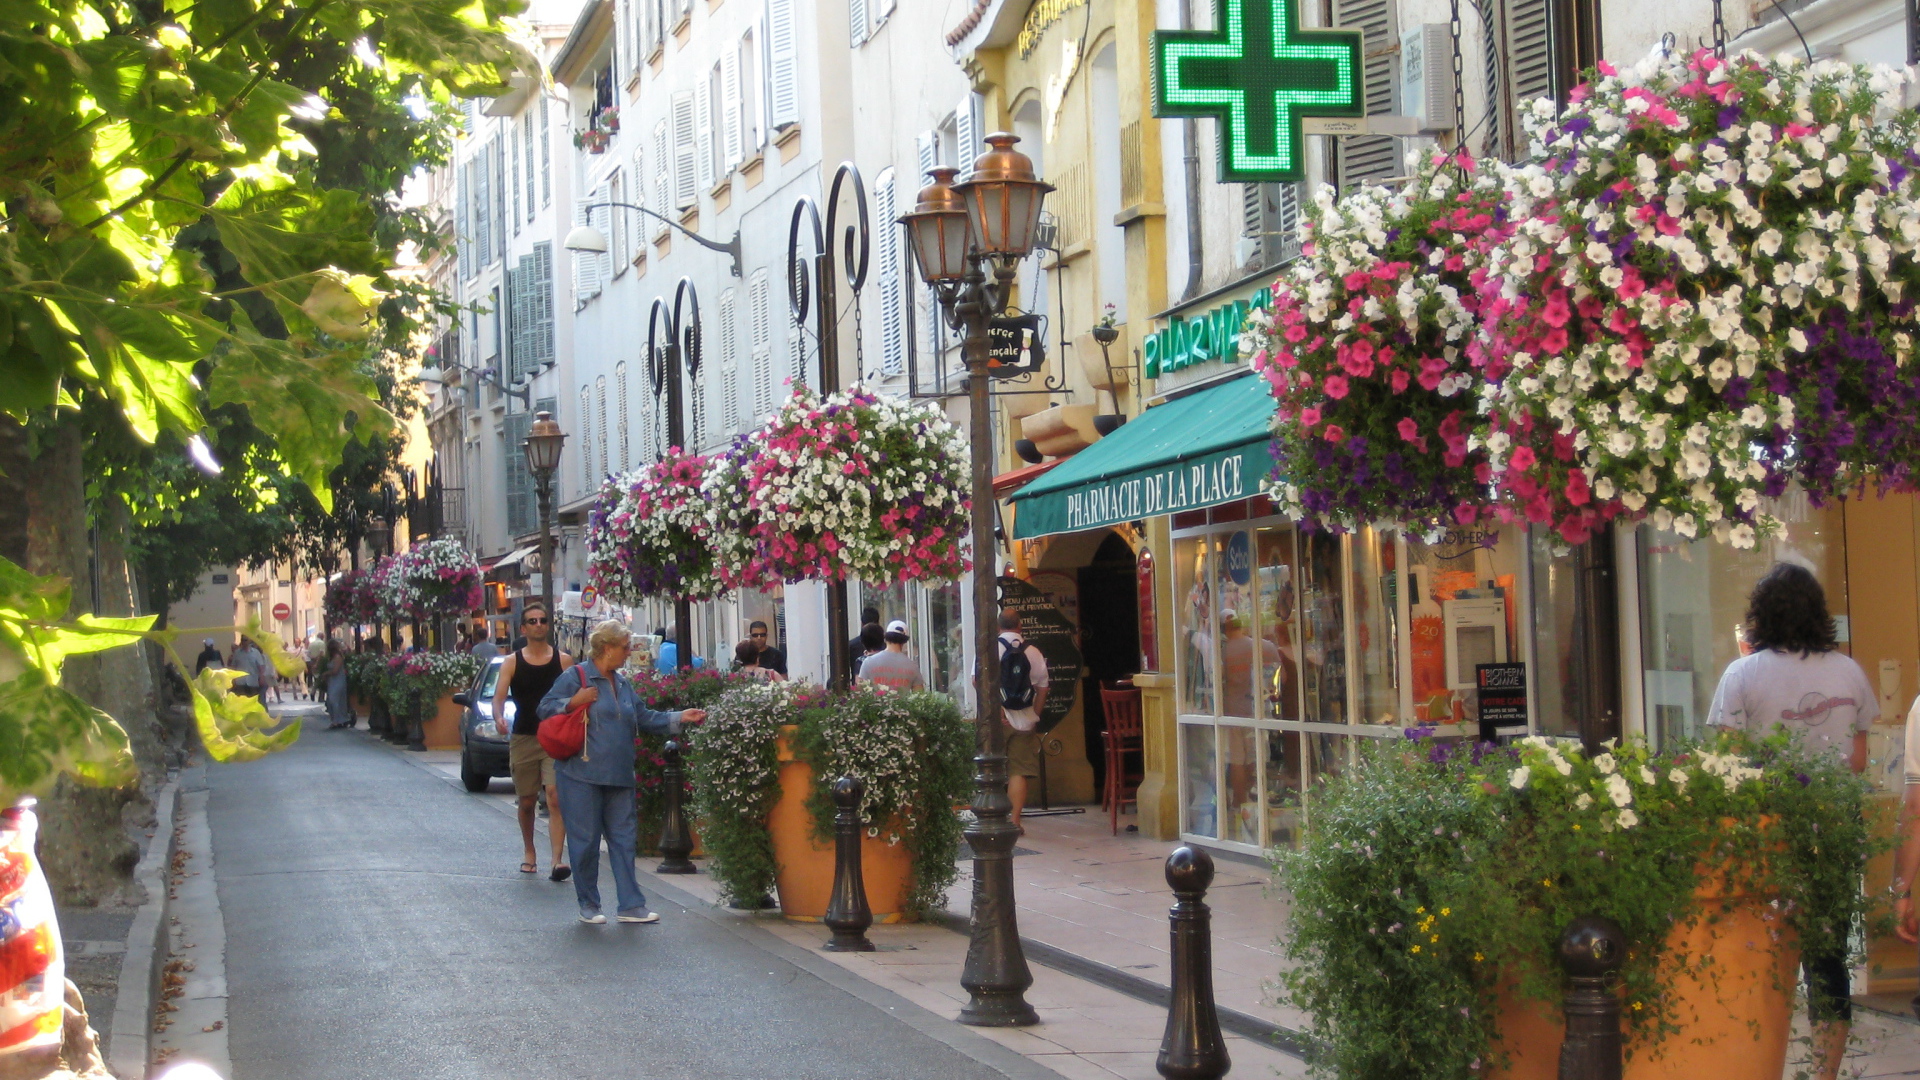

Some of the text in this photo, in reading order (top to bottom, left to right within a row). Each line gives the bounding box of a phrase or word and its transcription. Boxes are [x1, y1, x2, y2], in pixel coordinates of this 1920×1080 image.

[1067, 454, 1243, 529] PHARMACIE DE LA PLACE
[1229, 545, 1249, 570] Scho
[1420, 625, 1438, 637] 20
[1486, 668, 1524, 677] BIOTHERM
[1486, 678, 1519, 686] HOMME
